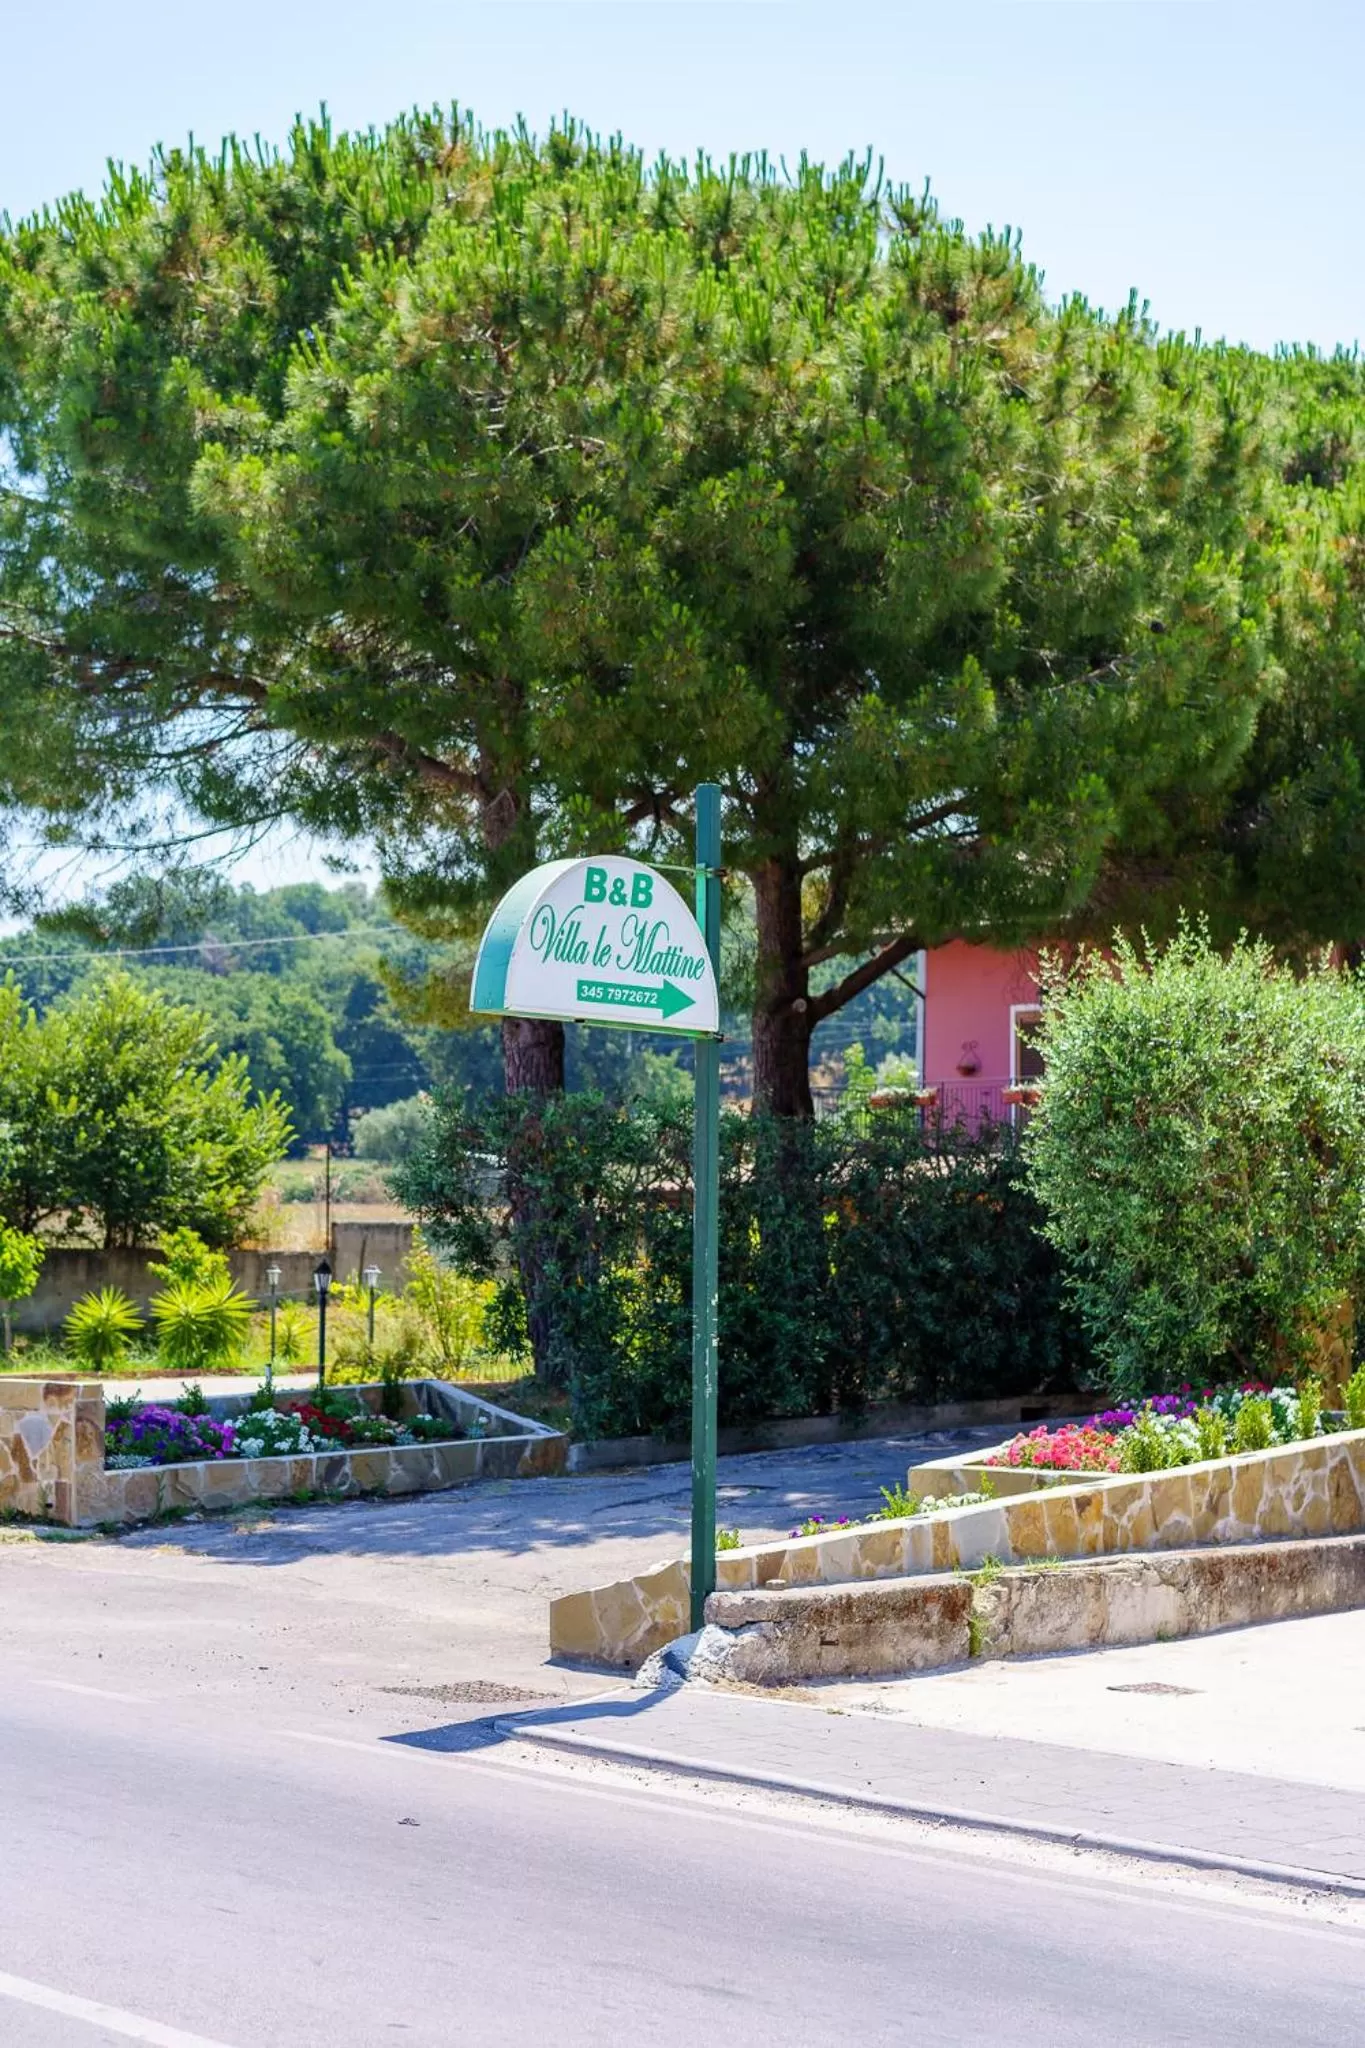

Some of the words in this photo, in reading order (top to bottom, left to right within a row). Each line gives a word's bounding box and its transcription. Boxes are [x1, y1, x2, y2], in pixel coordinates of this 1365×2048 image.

[584, 867, 653, 908] B&B
[530, 904, 589, 964] Villa
[593, 925, 611, 967] le
[616, 914, 704, 980] Mattine
[581, 986, 603, 999] 345
[607, 988, 658, 1004] 7972672
